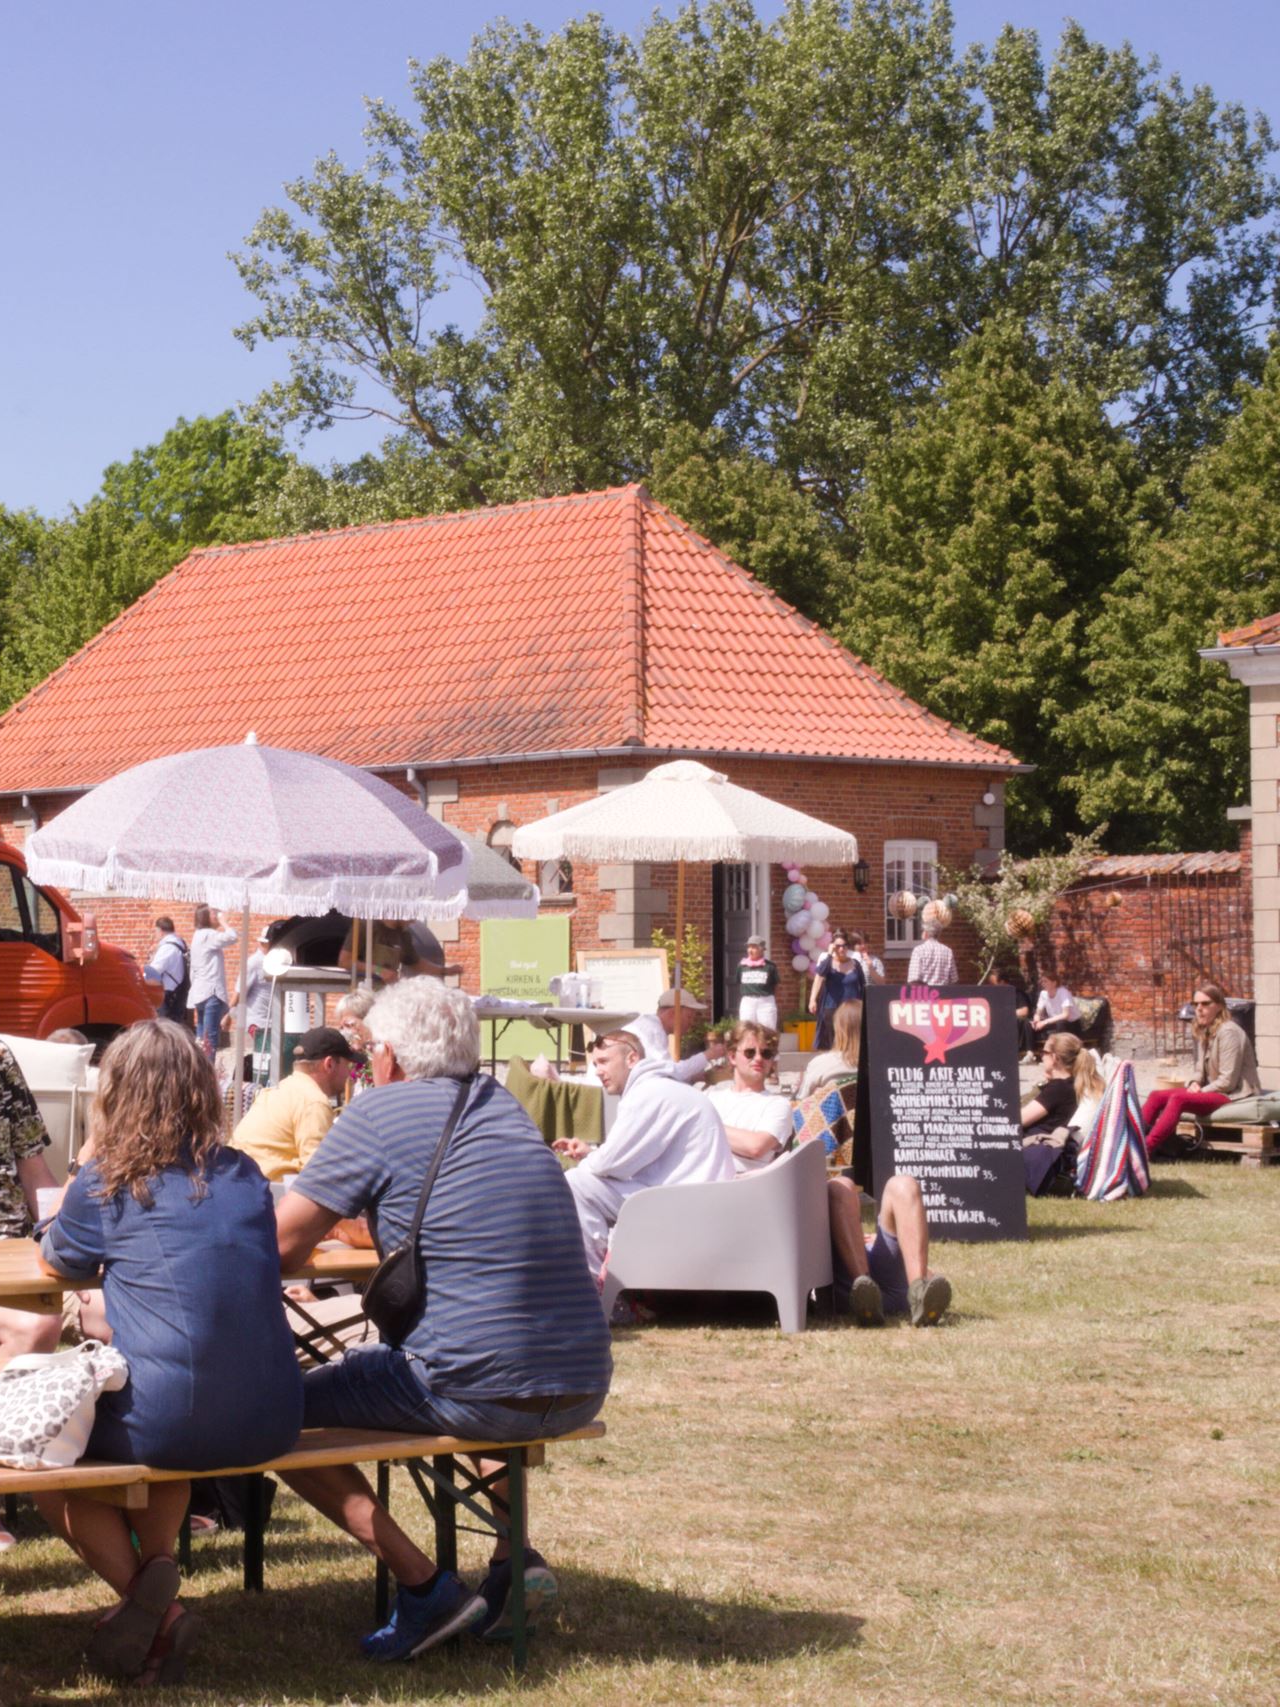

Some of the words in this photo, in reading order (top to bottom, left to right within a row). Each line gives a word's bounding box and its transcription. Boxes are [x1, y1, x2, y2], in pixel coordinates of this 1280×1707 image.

[506, 975, 534, 984] KIRKEN
[900, 985, 940, 1003] Lille
[891, 1003, 987, 1027] MEYER
